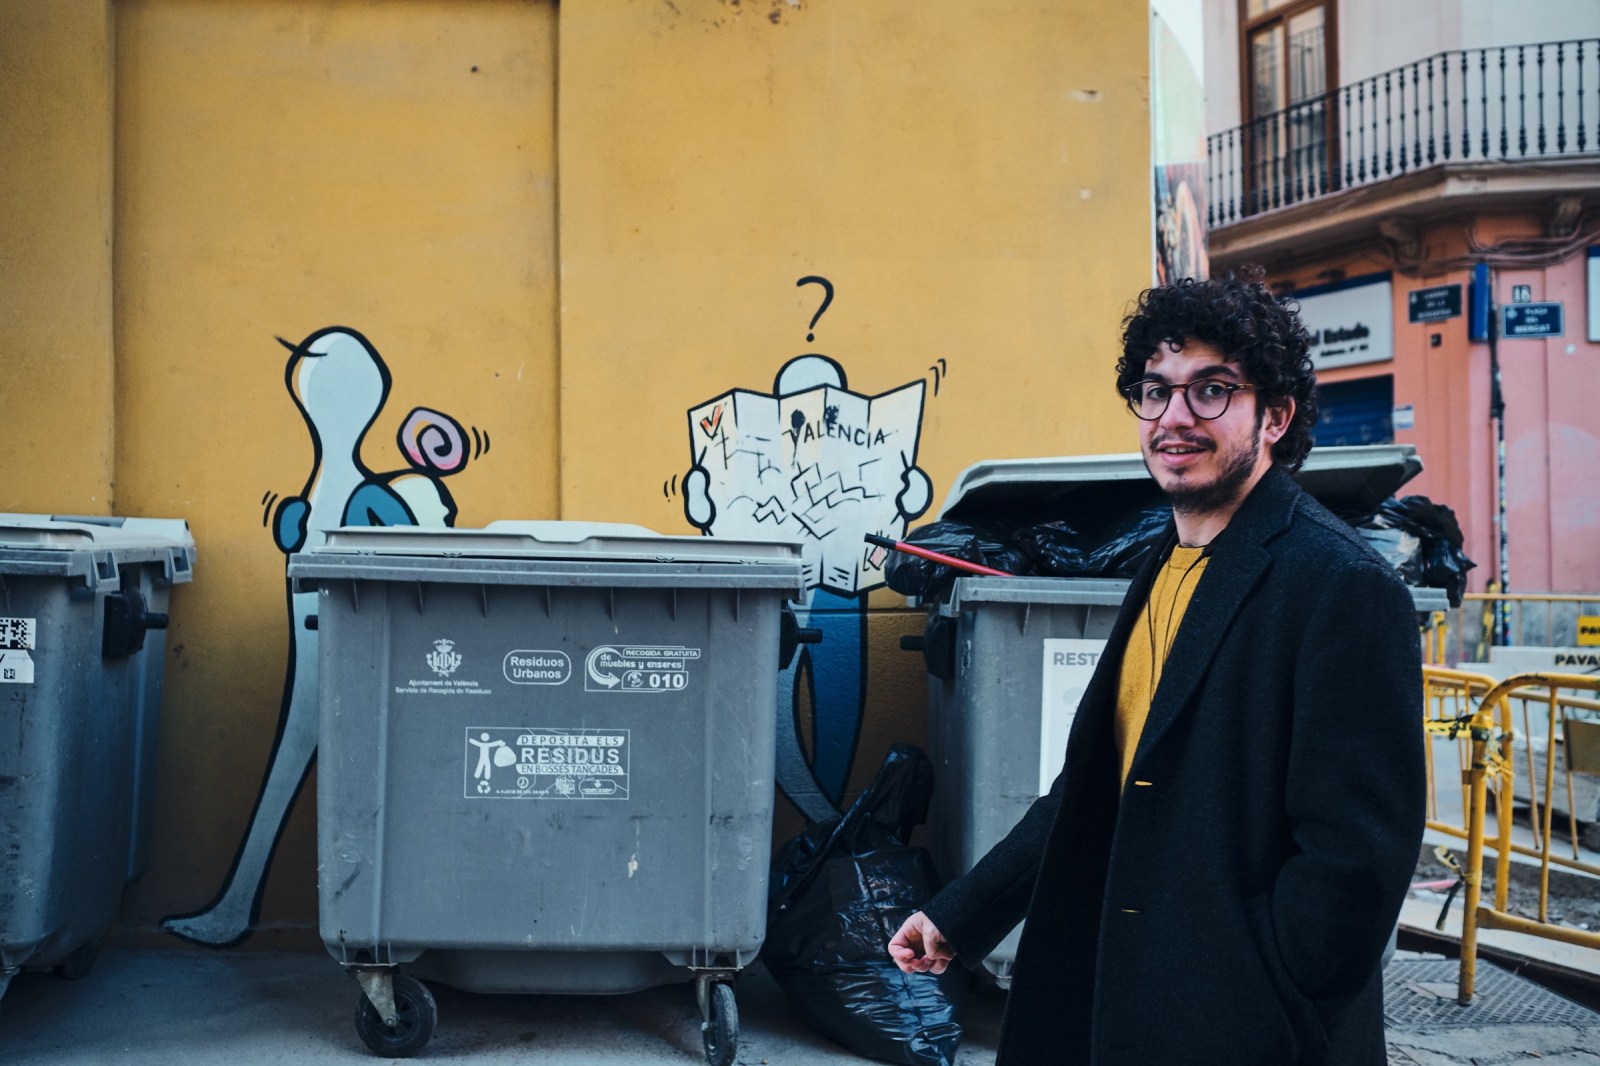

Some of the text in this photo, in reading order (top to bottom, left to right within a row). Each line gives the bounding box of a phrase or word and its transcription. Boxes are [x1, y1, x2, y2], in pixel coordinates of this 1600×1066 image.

[782, 418, 890, 449] VALENCIA
[1581, 626, 1600, 634] PA
[600, 653, 612, 661] de
[625, 649, 661, 657] RECOGIDA
[510, 656, 565, 667] Residuos
[600, 659, 682, 670] muebles y enseres
[1555, 654, 1600, 665] PAVA
[513, 668, 562, 678] Urbanos
[408, 679, 443, 687] Ajuntament
[649, 673, 684, 688] 010
[521, 736, 619, 746] DEPOSITA ELS
[521, 747, 620, 764] RESIDUS
[521, 765, 619, 774] EN BOSSES TANCADES
